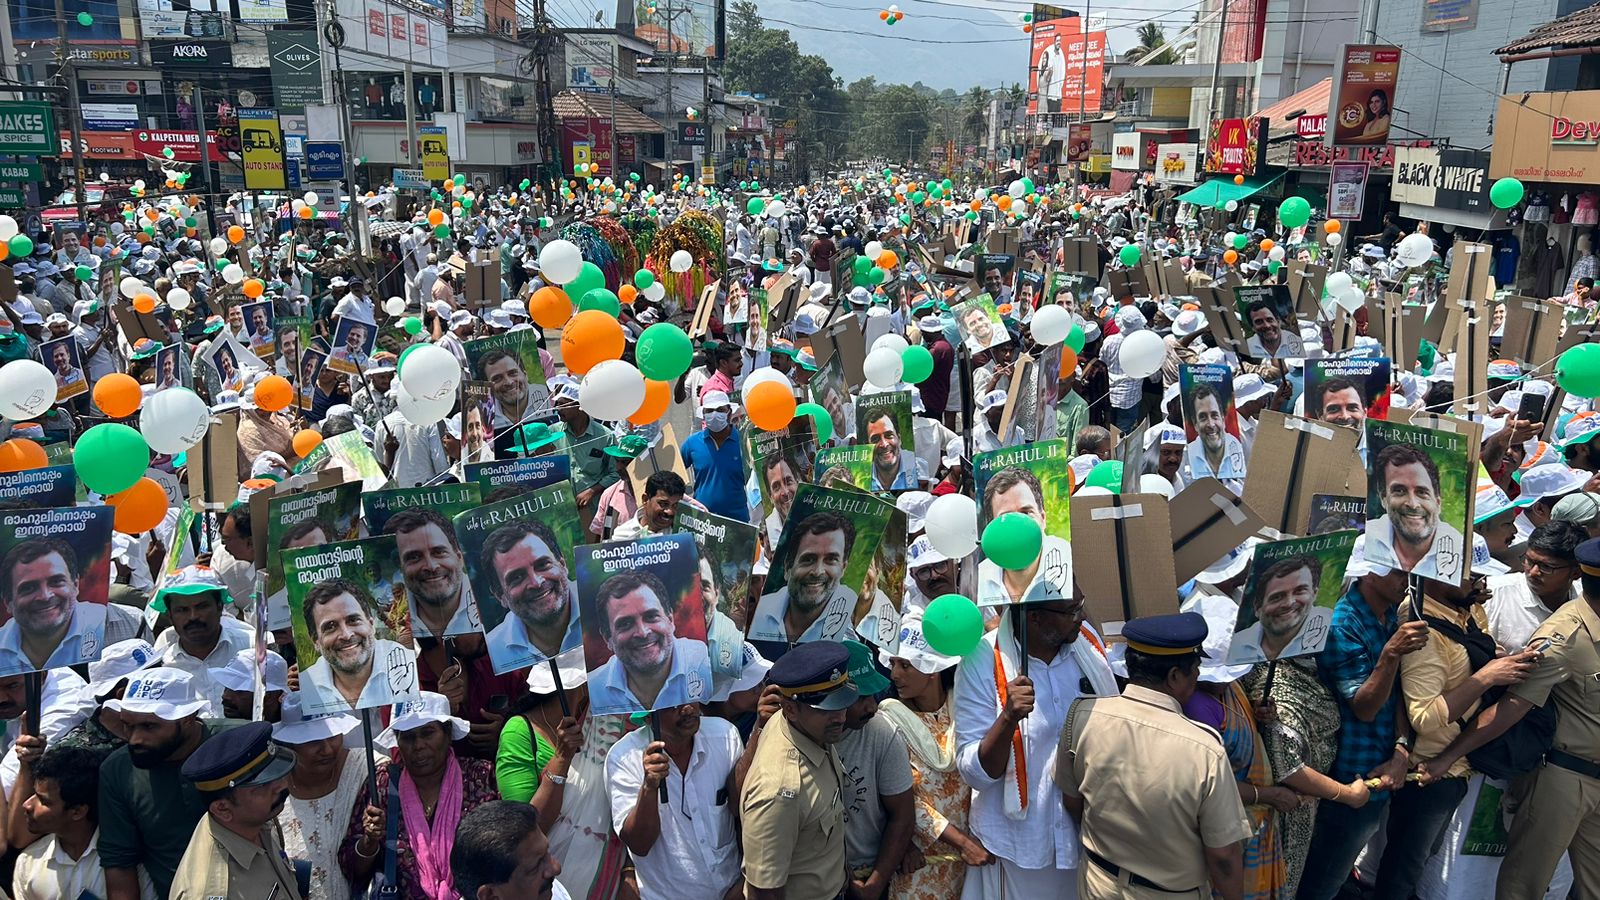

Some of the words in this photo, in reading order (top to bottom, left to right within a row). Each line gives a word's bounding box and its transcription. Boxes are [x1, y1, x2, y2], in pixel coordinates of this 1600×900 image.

[69, 49, 130, 61] starsports
[173, 45, 208, 57] AKORA
[151, 132, 181, 142] KALPETTA
[184, 132, 217, 144] MEDAL
[1228, 128, 1240, 145] VK
[1, 167, 29, 177] KABAB
[245, 162, 261, 171] AUTO
[263, 162, 283, 171] STAND
[1397, 162, 1433, 187] BLACK
[1444, 166, 1484, 193] WHITE
[484, 335, 520, 349] RAHUL
[870, 395, 898, 406] RAHUL
[1392, 428, 1444, 449] RAHUL
[1446, 439, 1457, 451] JI
[830, 451, 859, 463] RAHUL
[861, 450, 868, 461] JI
[996, 447, 1044, 468] RAHUL
[1046, 444, 1057, 459] JI
[396, 491, 456, 508] RAHUL
[458, 489, 471, 503] JI
[823, 496, 871, 515] RAHUL
[873, 504, 885, 516] JI
[489, 497, 551, 525] RAHUL
[552, 490, 564, 506] JI
[4, 510, 96, 525] രാഹുലിനൊപ്പം
[591, 540, 680, 560] രാഹുലിനൊപ്പം
[1284, 539, 1334, 556] RAHUL
[1336, 535, 1349, 547] JI
[142, 680, 153, 698] UDF
[848, 765, 867, 814] EAGLE
